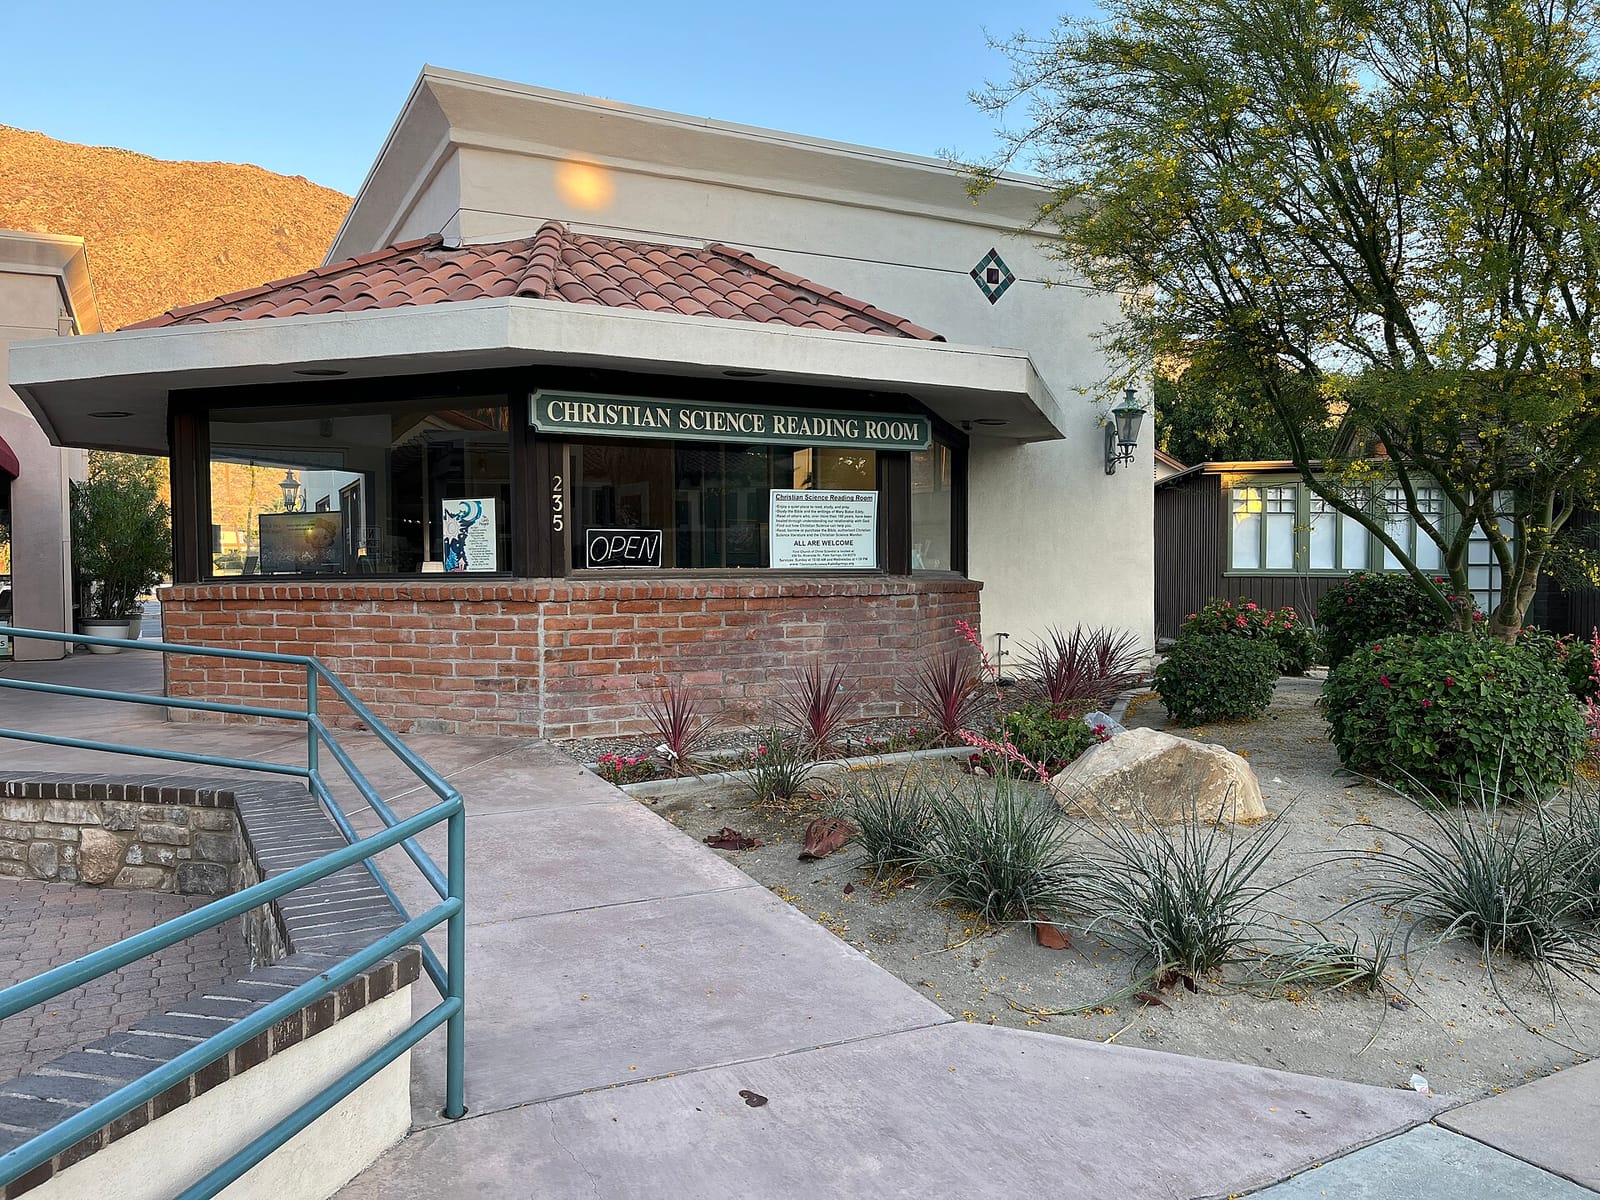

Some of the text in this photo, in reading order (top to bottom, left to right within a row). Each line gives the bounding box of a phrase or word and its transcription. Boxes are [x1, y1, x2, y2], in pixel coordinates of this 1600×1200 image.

[546, 400, 919, 441] CHRISTIAN SCIENCE READING ROOM
[553, 476, 563, 531] 235
[590, 536, 658, 561] OPEN
